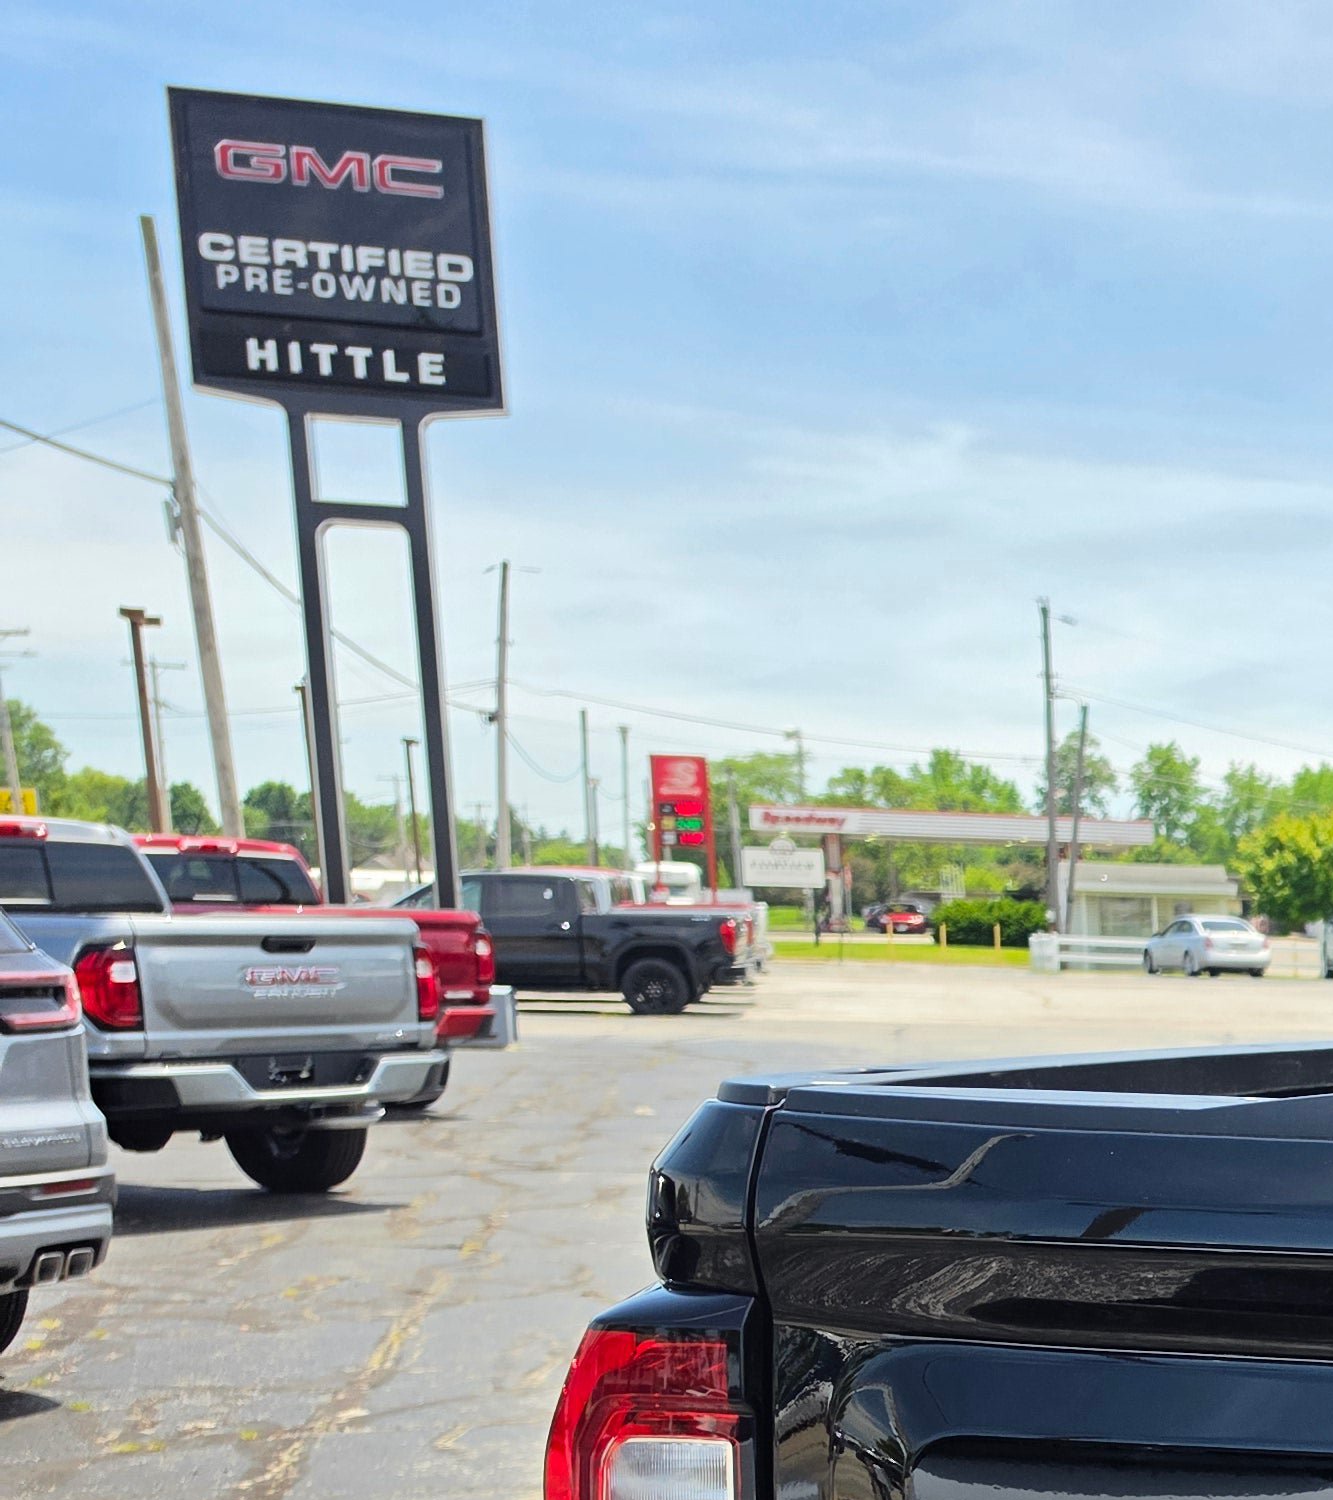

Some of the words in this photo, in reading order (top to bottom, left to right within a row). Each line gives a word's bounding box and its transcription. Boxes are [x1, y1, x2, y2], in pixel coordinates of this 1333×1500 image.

[214, 139, 444, 199] GMC
[199, 232, 474, 282] CERTIFIED
[217, 265, 461, 309] PRE-OWNED
[245, 337, 447, 386] HITTLE
[245, 966, 341, 988] GMC
